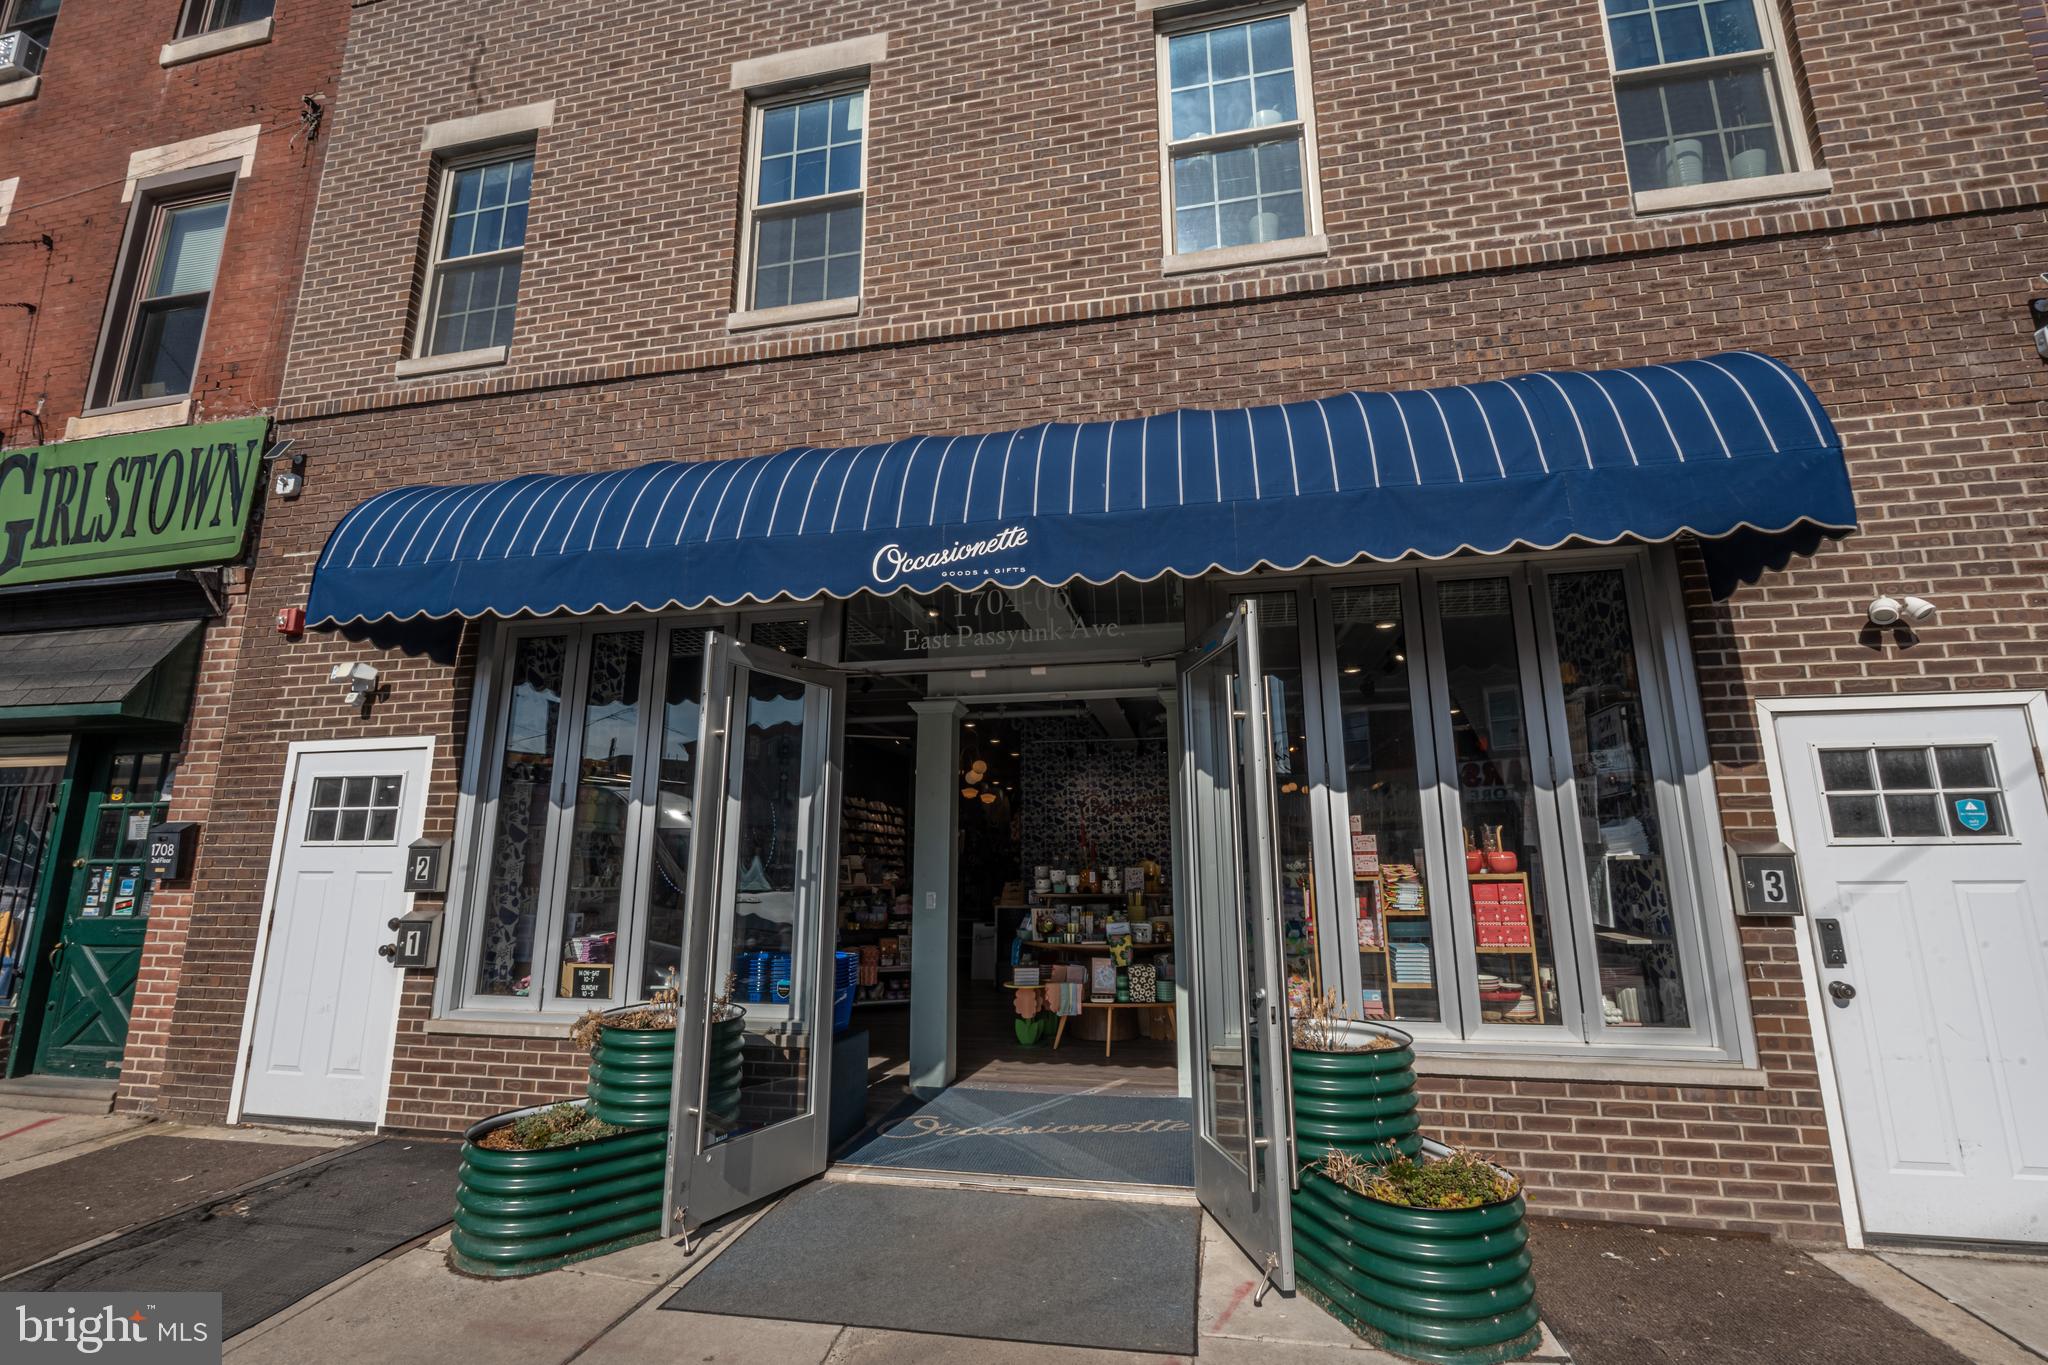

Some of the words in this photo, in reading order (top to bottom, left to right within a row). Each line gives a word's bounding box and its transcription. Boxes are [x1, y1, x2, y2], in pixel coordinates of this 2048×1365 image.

[0, 439, 258, 577] GIRLSTOWN
[871, 525, 1029, 583] Occasionette
[941, 569, 979, 577] GOODS
[994, 566, 1026, 574] GIFTS
[903, 629, 950, 651] East
[957, 621, 1064, 650] Passyunk
[1070, 616, 1126, 640] Ave.
[151, 843, 175, 857] 1708
[416, 857, 428, 880] 2
[1765, 870, 1784, 902] 3
[409, 932, 418, 955] 1
[875, 1114, 1193, 1139] Occasionette
